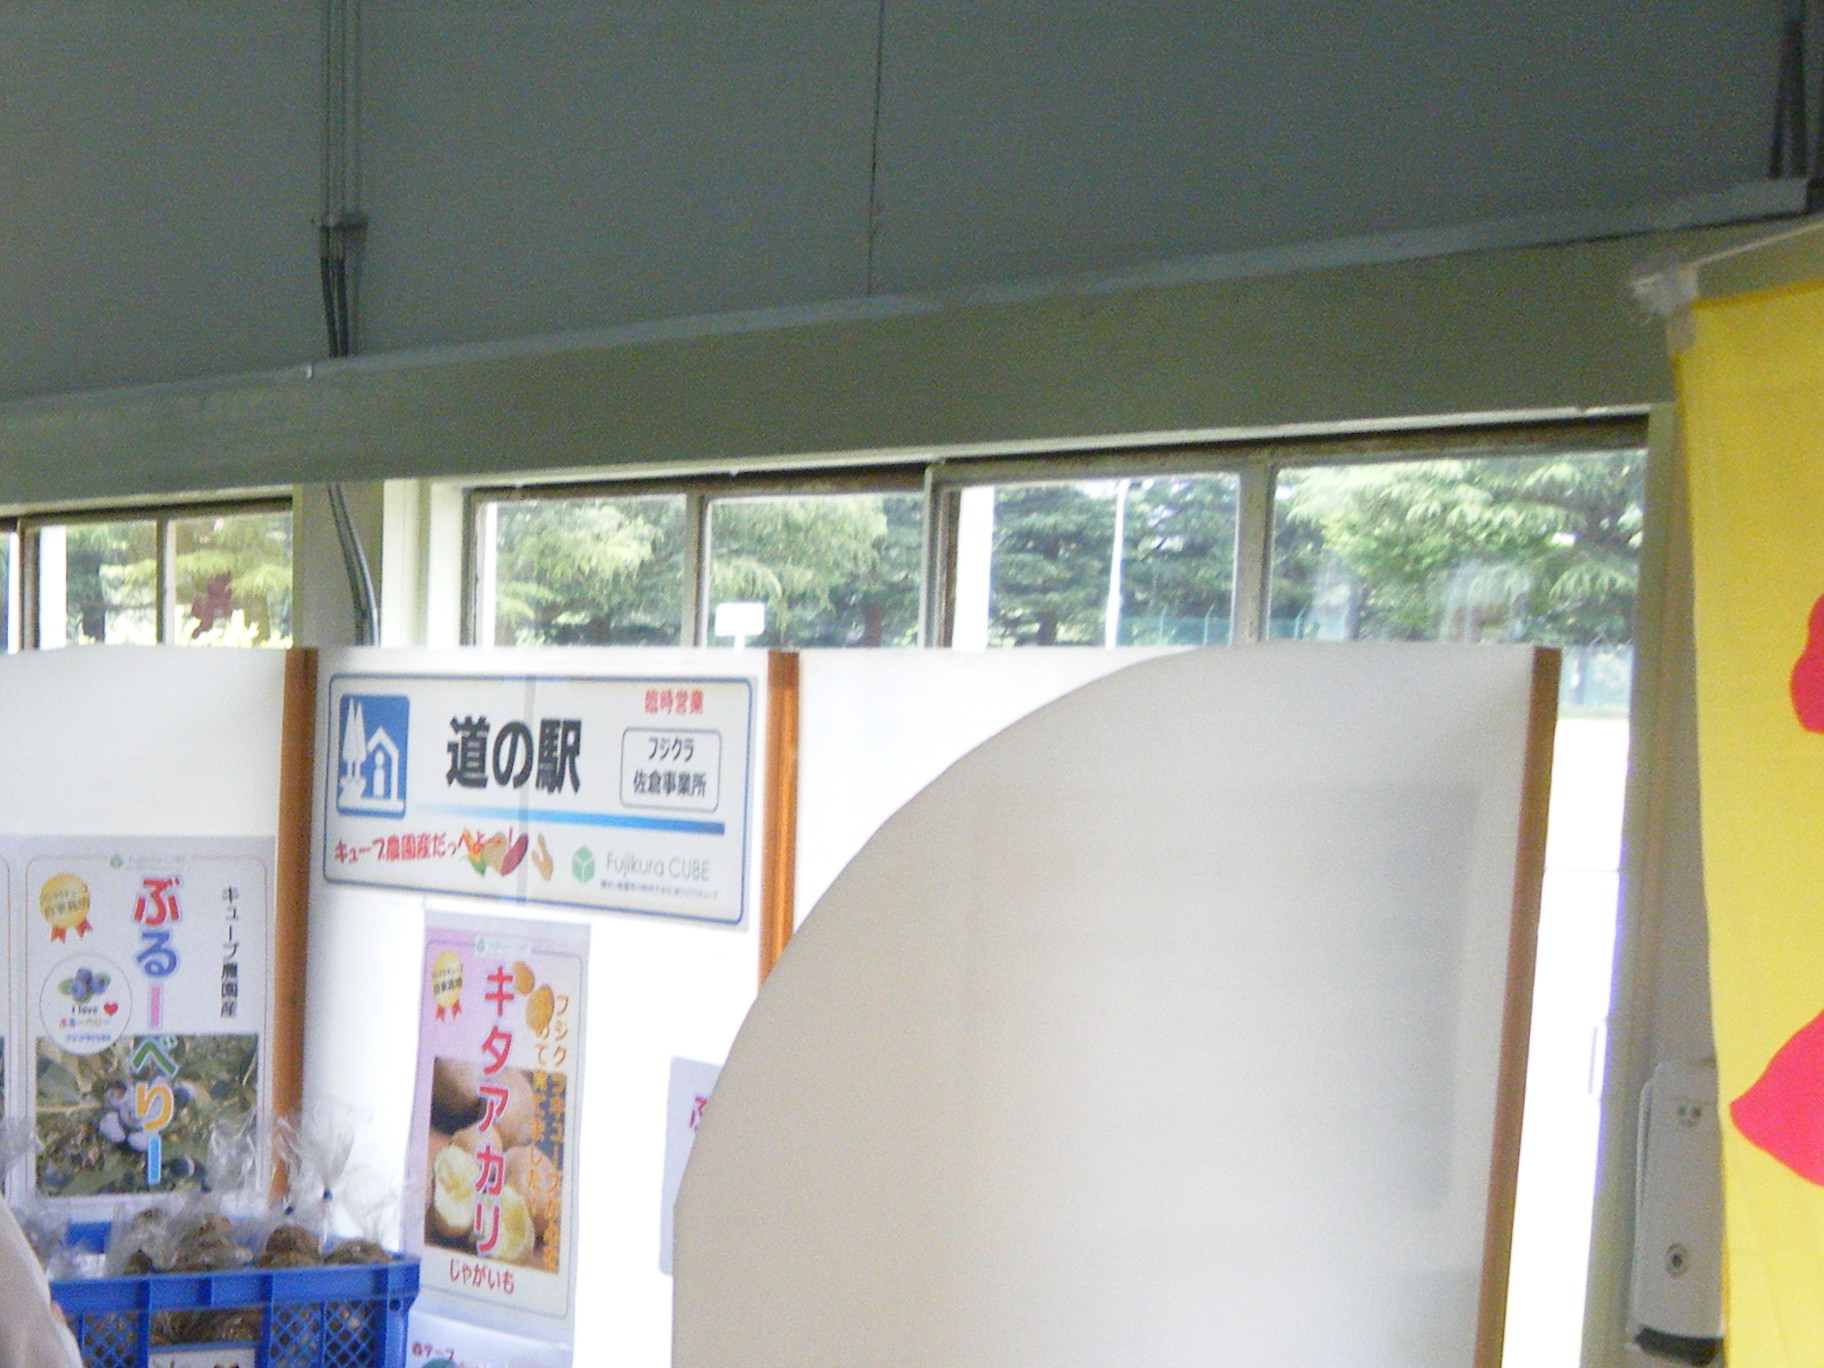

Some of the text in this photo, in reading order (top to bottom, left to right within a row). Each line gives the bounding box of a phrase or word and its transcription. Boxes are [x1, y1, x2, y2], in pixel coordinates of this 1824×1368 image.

[445, 714, 583, 794] 道の駅
[648, 736, 695, 763] フジクラ
[606, 850, 711, 882] Fujikura CUBE
[130, 876, 182, 1186] ぶるーべりー
[474, 965, 515, 1253] キタアカリ
[449, 1257, 515, 1295] じゃがいも
